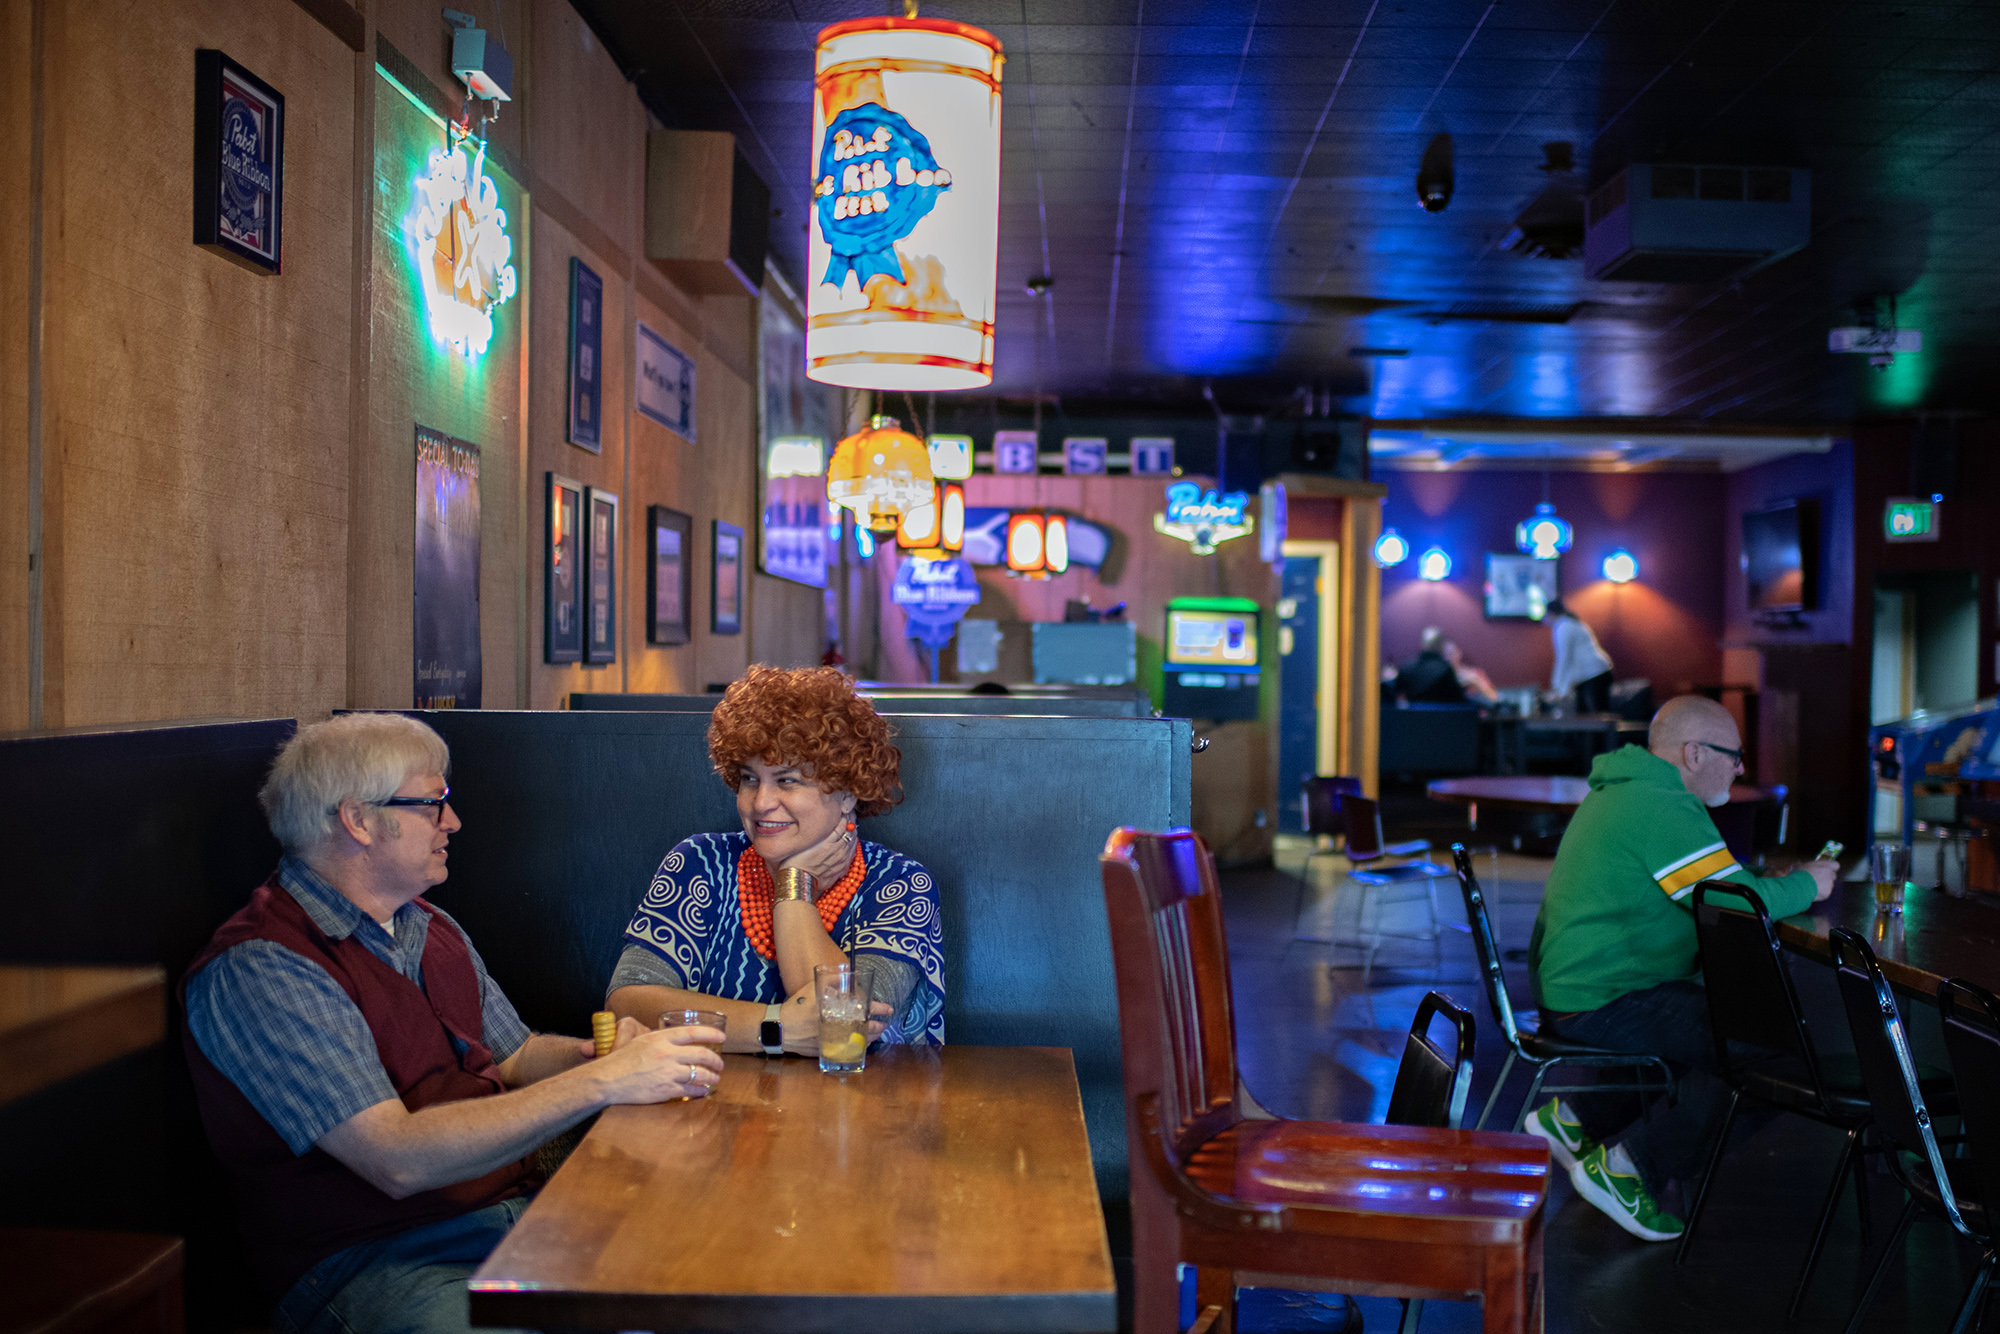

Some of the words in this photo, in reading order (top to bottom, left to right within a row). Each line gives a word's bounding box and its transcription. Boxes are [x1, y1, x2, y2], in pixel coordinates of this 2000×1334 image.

[232, 113, 257, 155] Pabst
[834, 126, 892, 161] Pabst
[222, 140, 242, 172] Blue
[241, 152, 271, 191] Ribbon
[417, 434, 450, 469] SPECIAL
